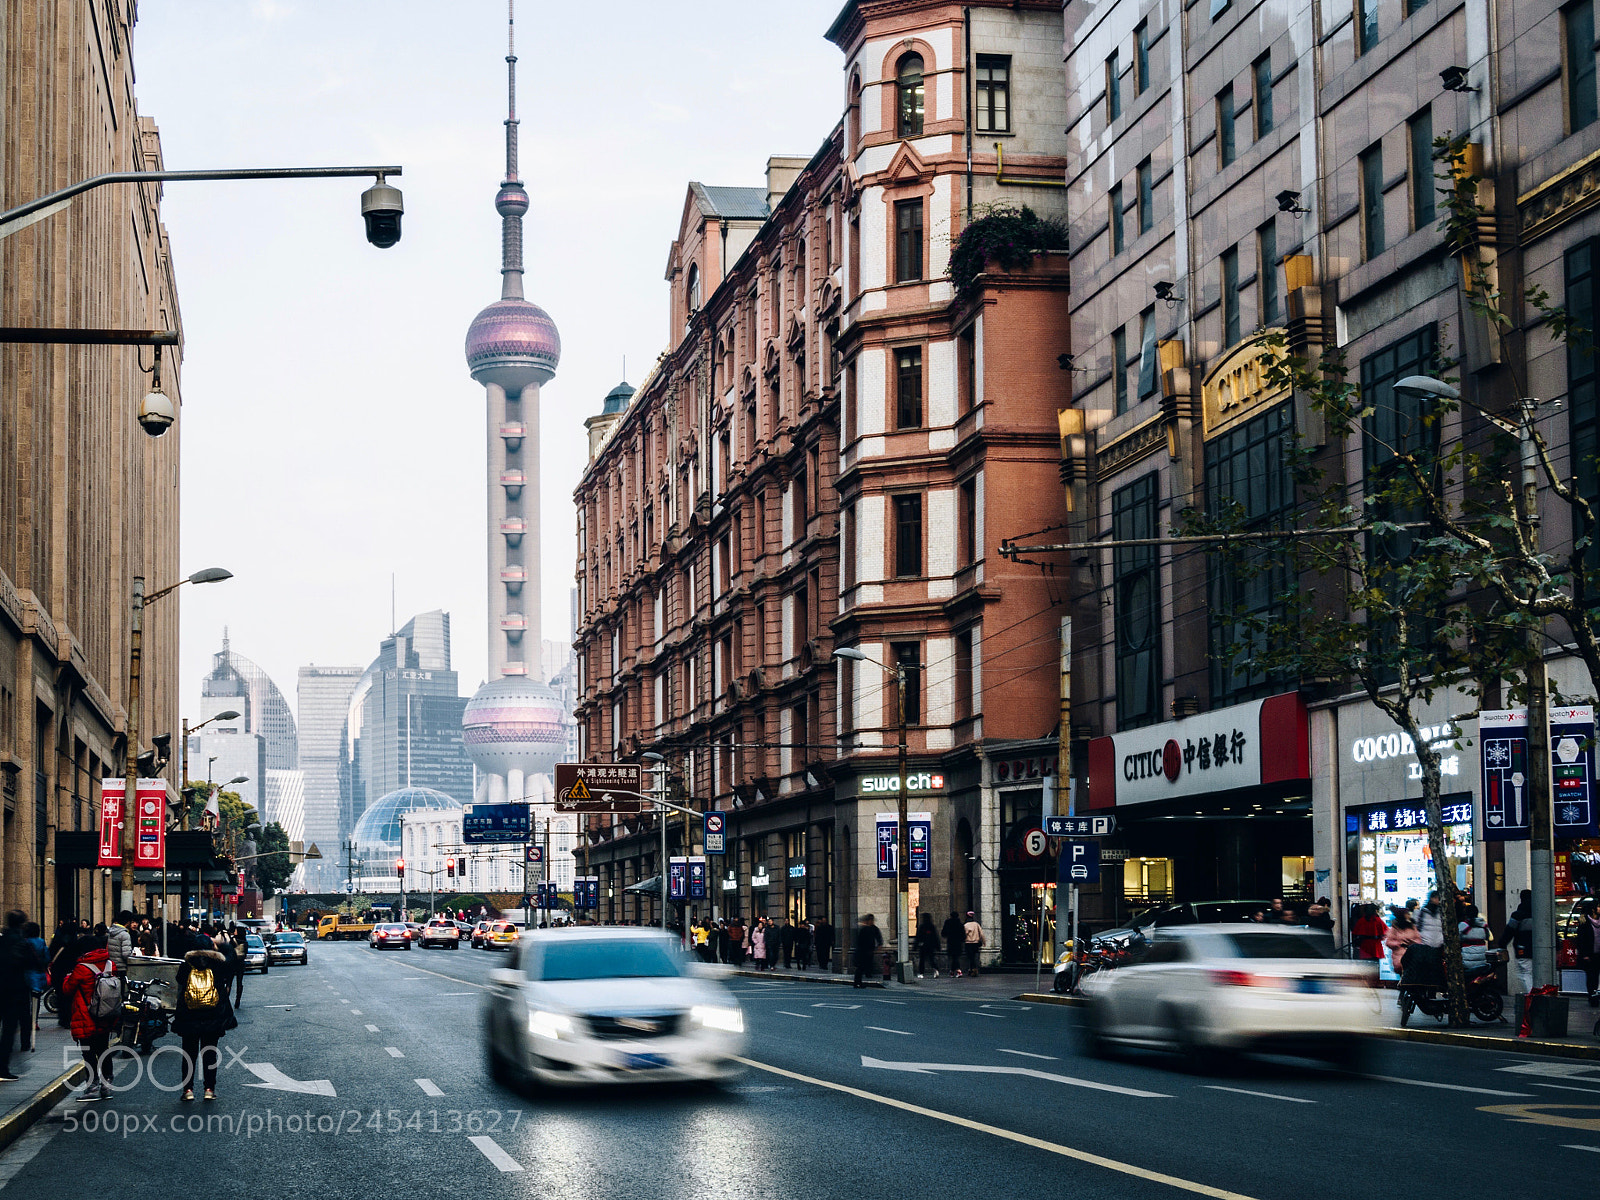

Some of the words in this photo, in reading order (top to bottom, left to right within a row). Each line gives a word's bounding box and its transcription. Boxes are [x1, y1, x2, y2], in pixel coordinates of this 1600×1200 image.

[576, 768, 638, 778] 外滩观光隧道
[1123, 748, 1163, 782] CITIC
[862, 773, 931, 792] swach
[1051, 821, 1088, 832] 停车库
[1095, 819, 1105, 833] P
[1031, 835, 1040, 851] 5
[1073, 845, 1085, 863] P
